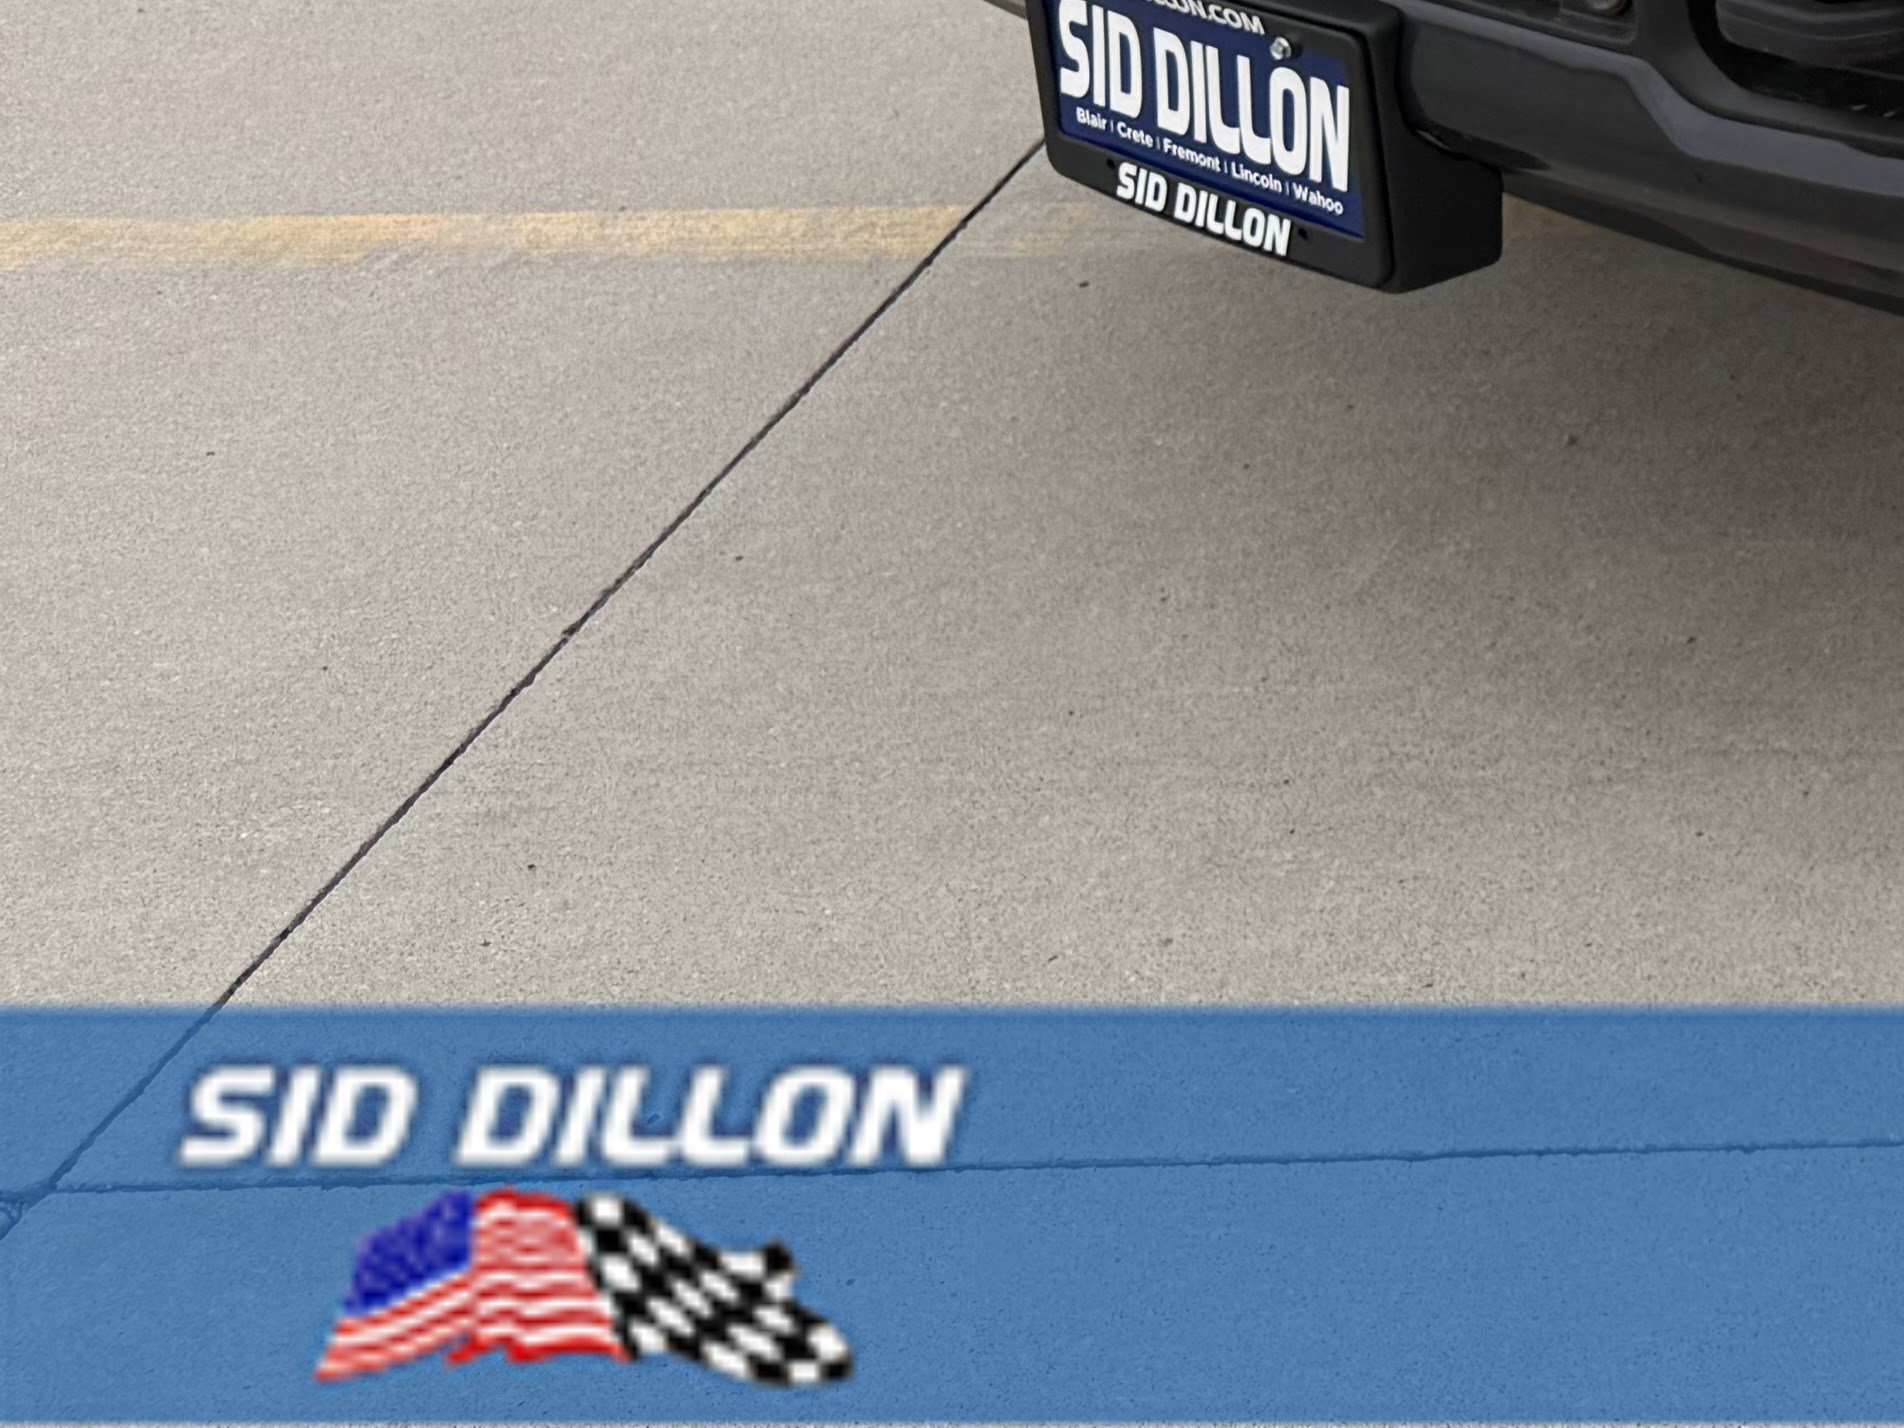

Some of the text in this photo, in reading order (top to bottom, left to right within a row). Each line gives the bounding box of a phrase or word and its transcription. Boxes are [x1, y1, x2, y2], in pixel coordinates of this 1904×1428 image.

[1075, 106, 1345, 216] Blair Crete Fremont Lincoln Wahoo
[1153, 27, 1351, 192] DILLON
[1115, 162, 1292, 257] SID DILLON
